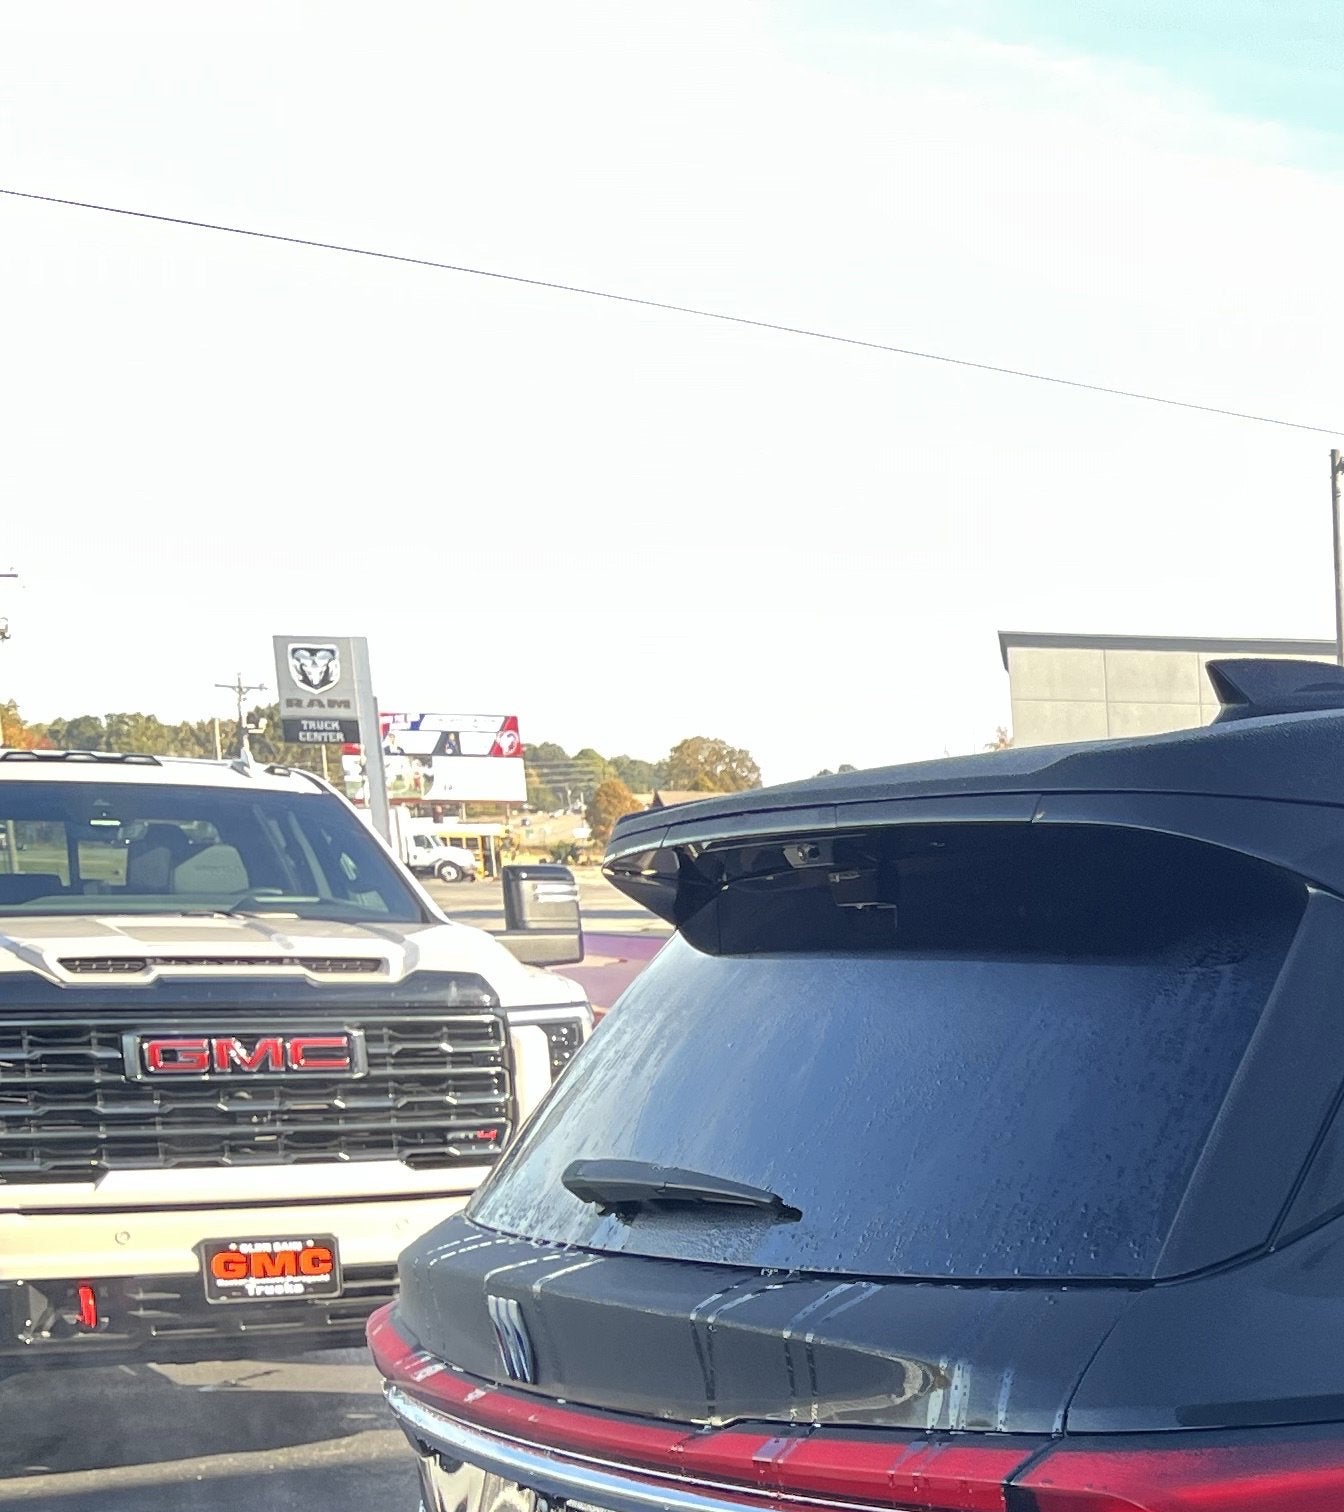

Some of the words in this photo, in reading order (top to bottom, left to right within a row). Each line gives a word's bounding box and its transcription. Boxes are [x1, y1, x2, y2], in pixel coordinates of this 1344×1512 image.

[286, 699, 350, 709] RAM
[301, 720, 340, 731] TRUCK
[298, 731, 345, 742] CENTER
[143, 1037, 349, 1072] GMC
[211, 1247, 333, 1280] GMC
[245, 1281, 304, 1297] Trucks
